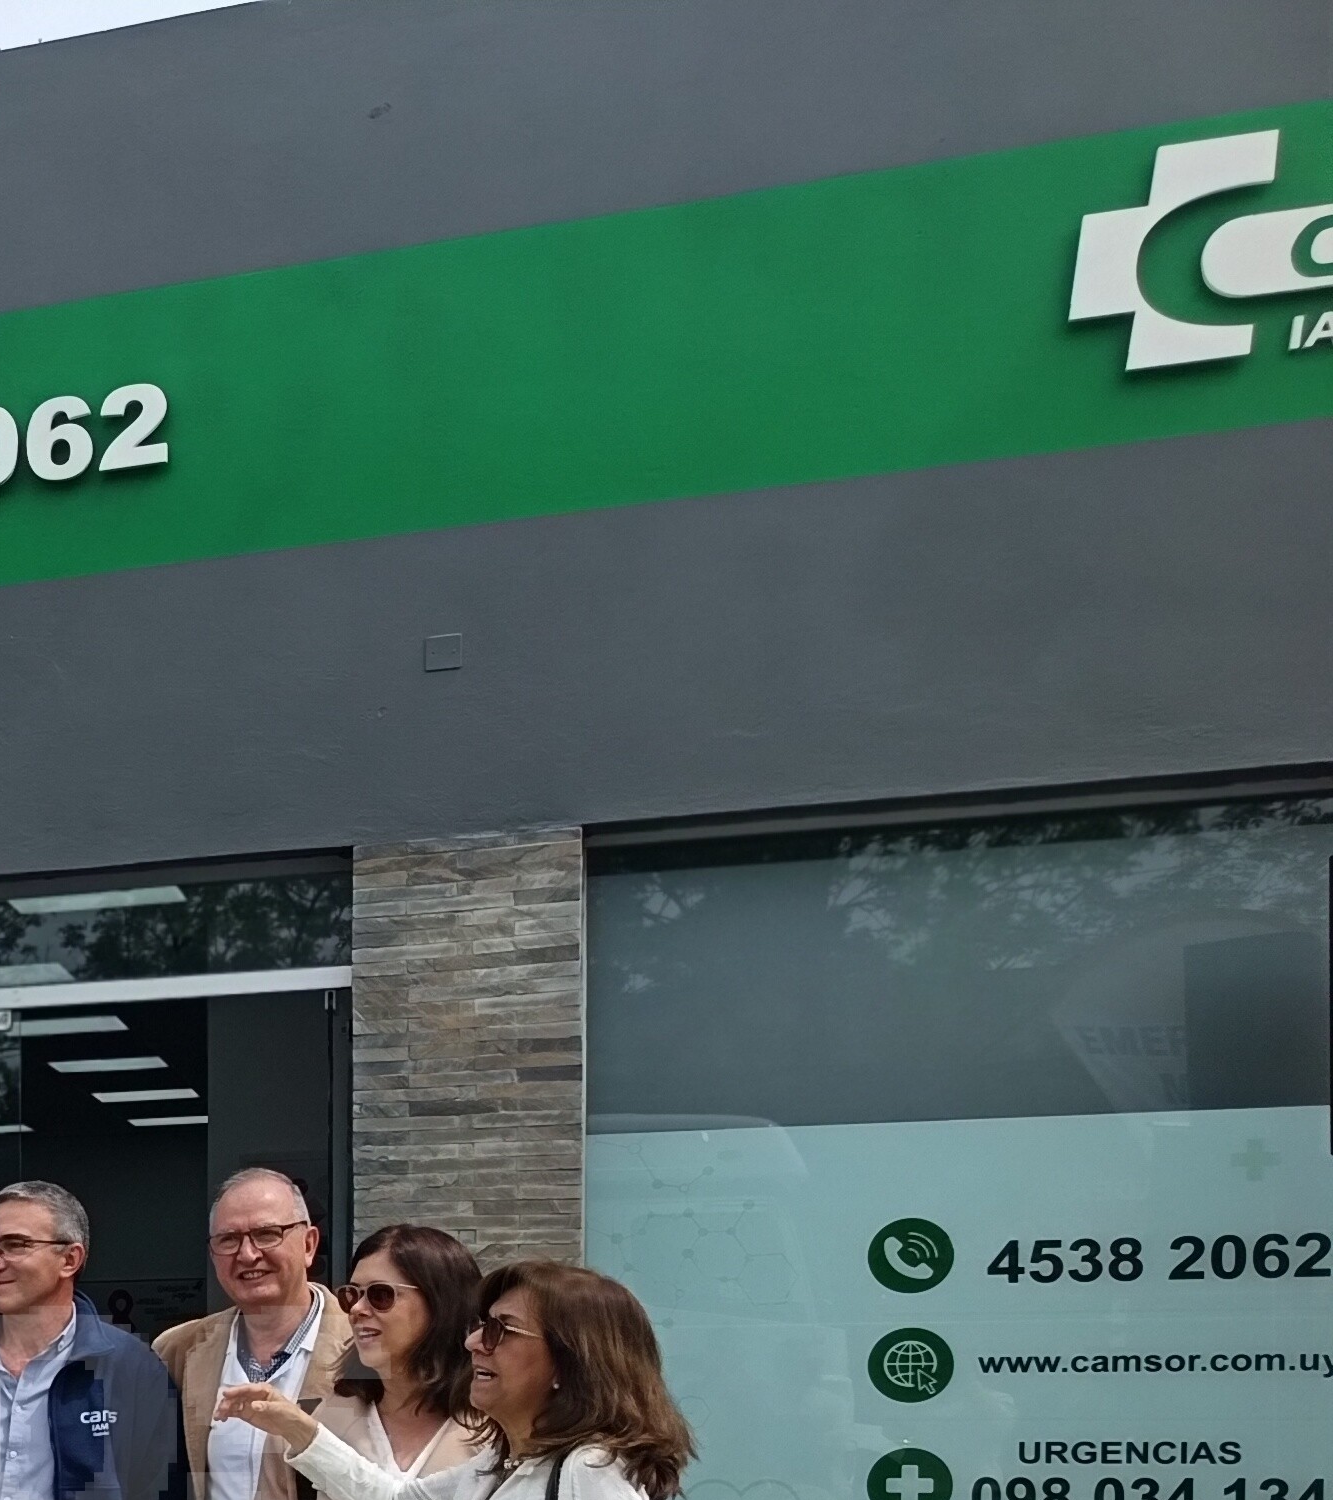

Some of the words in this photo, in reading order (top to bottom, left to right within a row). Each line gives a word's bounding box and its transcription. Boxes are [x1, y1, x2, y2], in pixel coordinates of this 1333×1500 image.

[987, 1237, 1144, 1283] 4538
[1168, 1232, 1333, 1280] 2062
[978, 1353, 1333, 1378] www.camsor.com.uy
[1018, 1441, 1242, 1465] URGENCIAS
